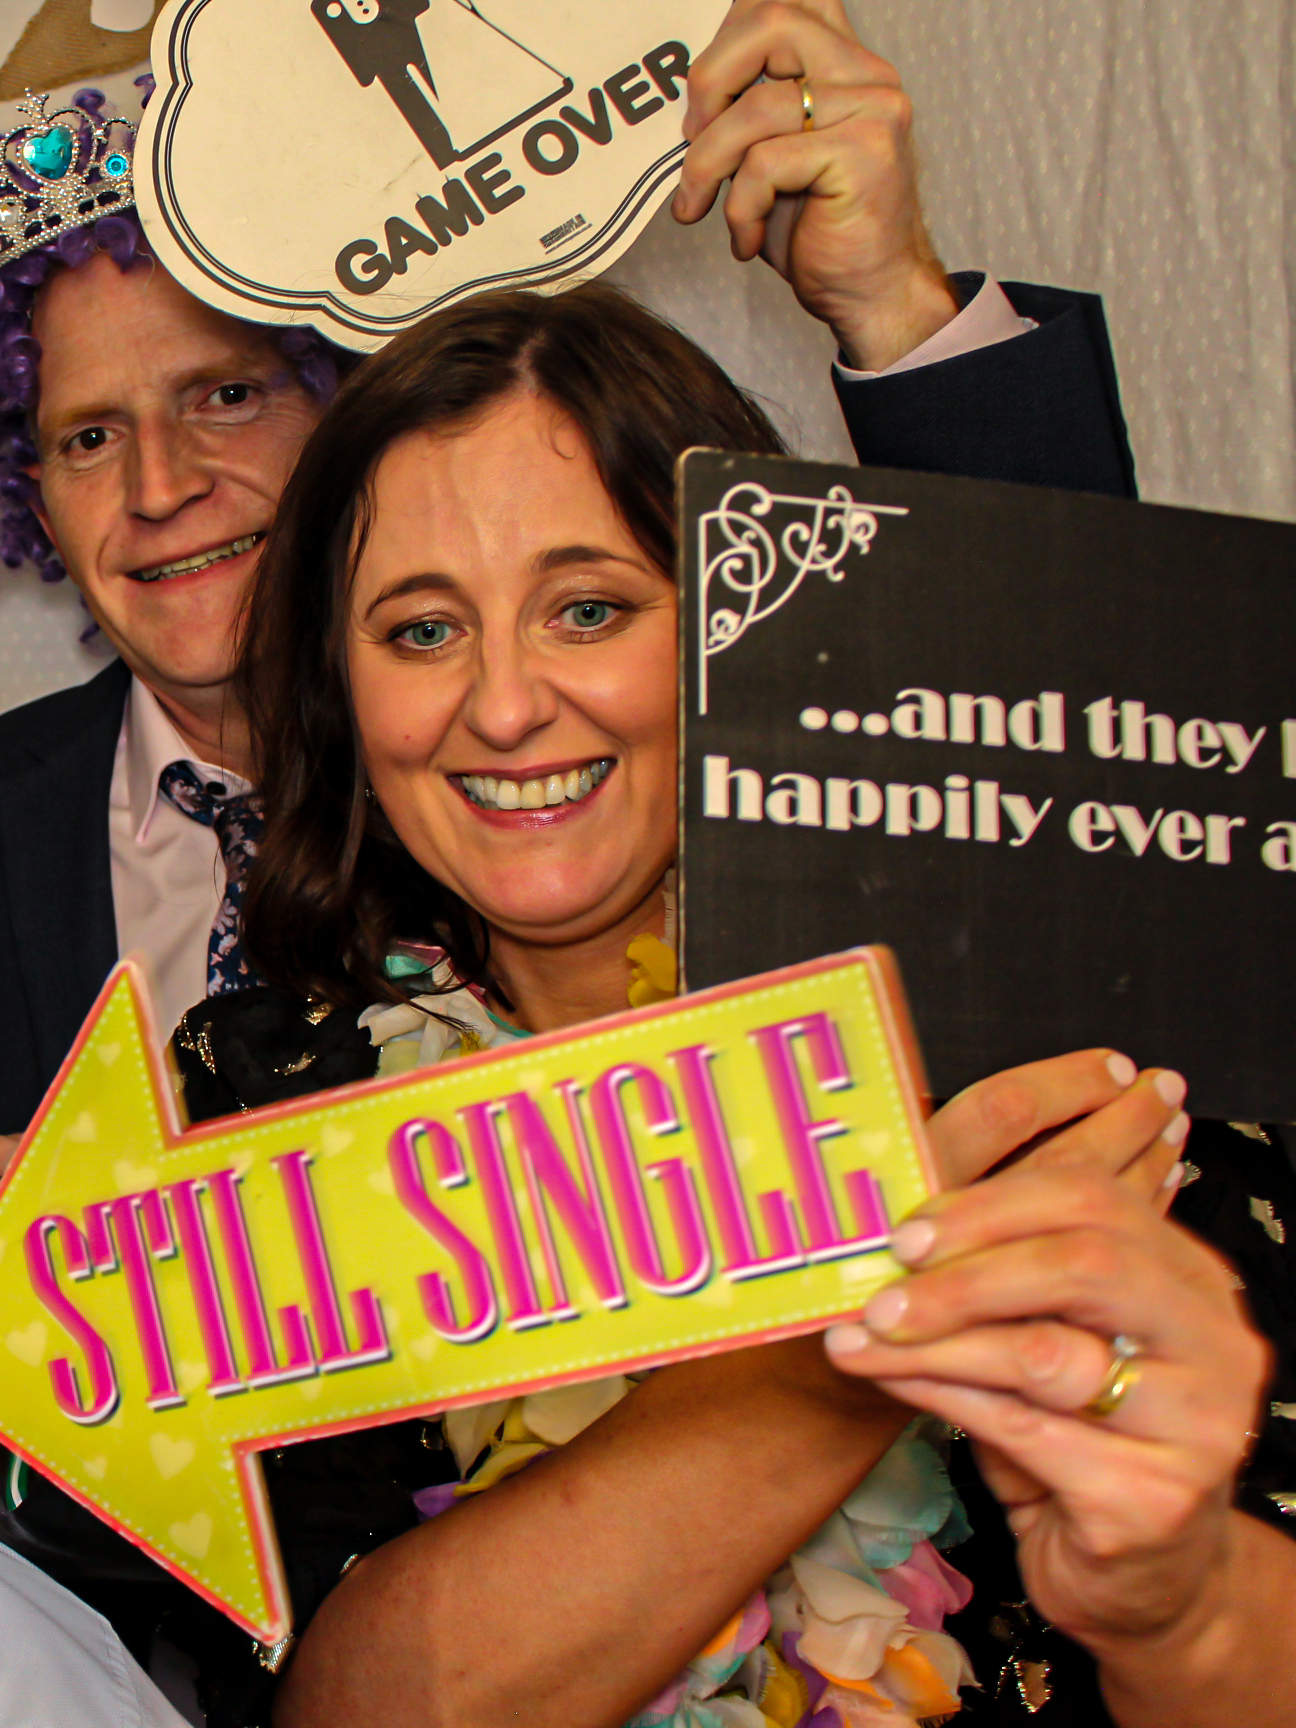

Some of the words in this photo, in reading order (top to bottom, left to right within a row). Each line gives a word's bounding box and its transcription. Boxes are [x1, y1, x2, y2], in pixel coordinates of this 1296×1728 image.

[334, 152, 526, 296] GAME
[521, 40, 691, 176] OVER
[702, 754, 1053, 847] happily
[1068, 800, 1247, 865] ever
[1083, 696, 1267, 774] they
[22, 1148, 391, 1425] STILL
[386, 1010, 893, 1344] SINGLE
